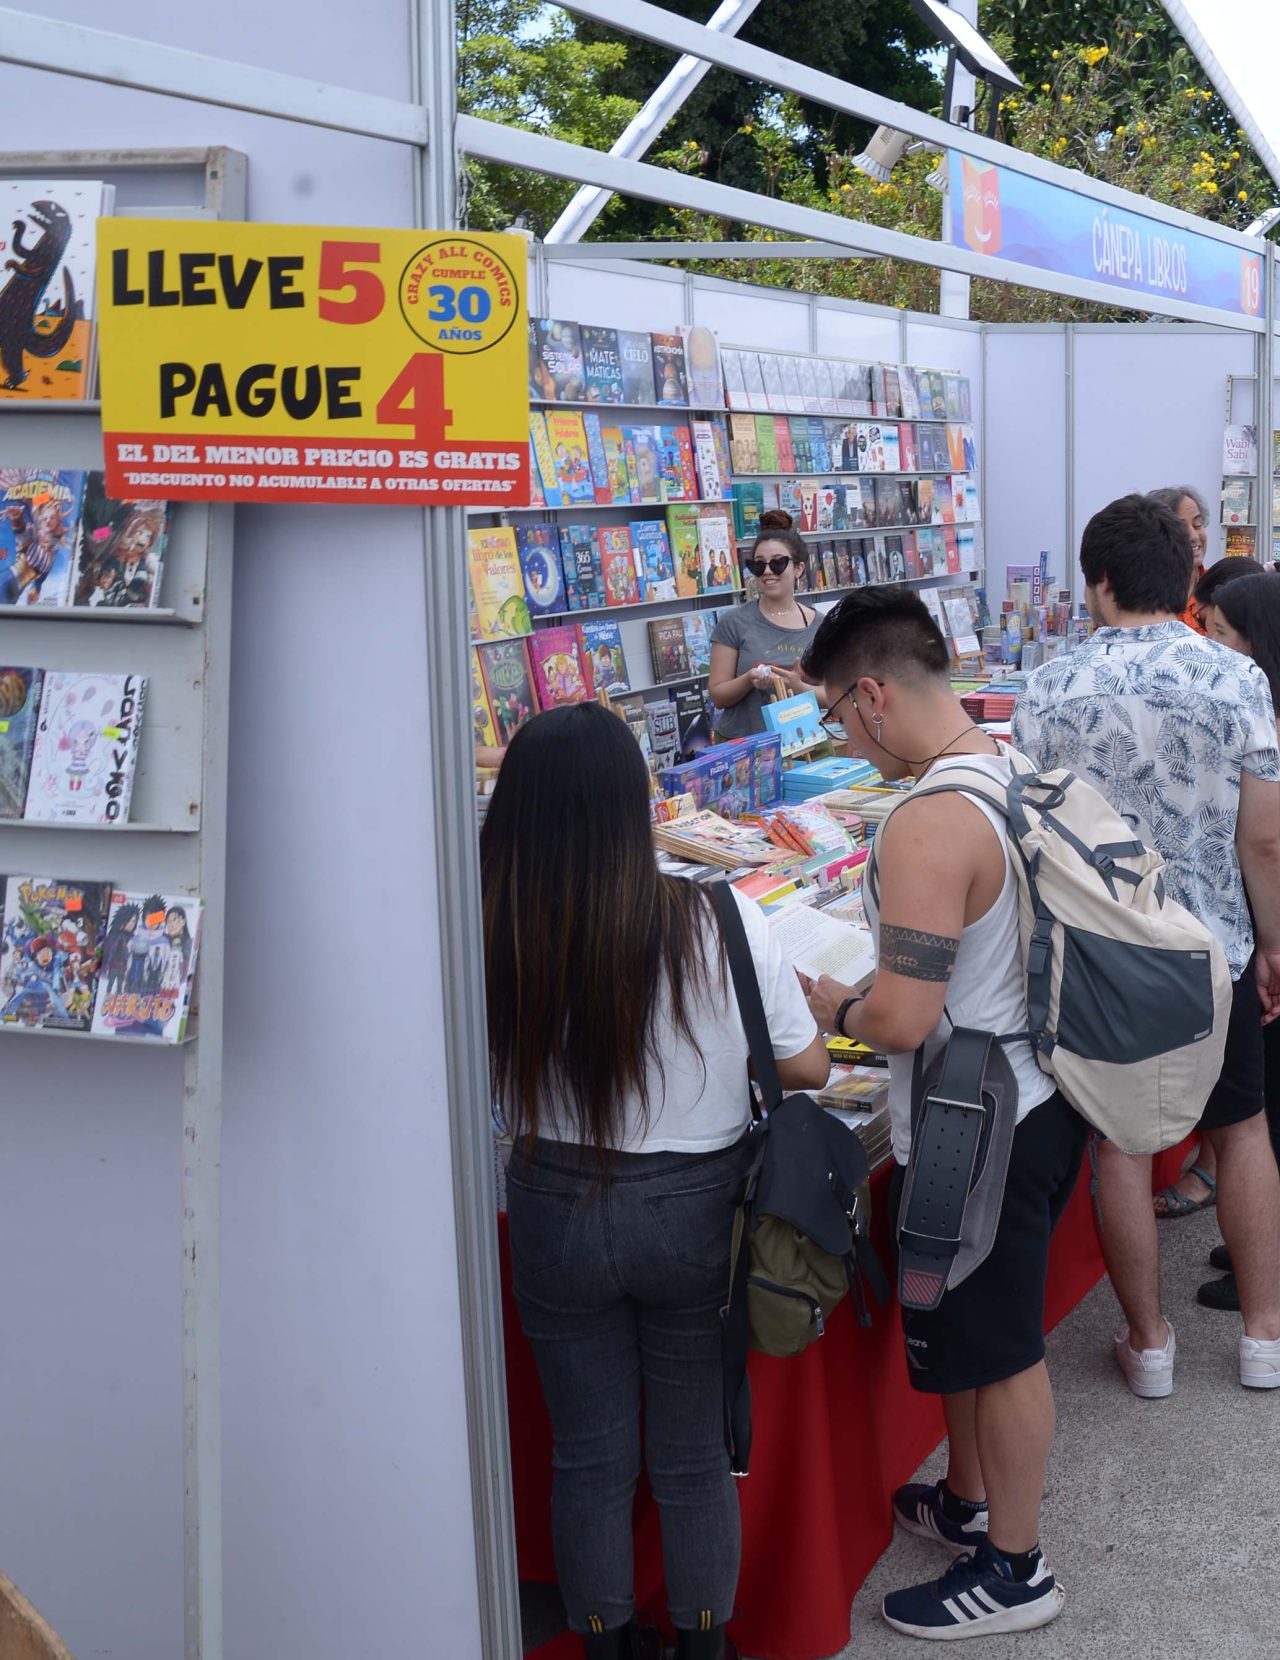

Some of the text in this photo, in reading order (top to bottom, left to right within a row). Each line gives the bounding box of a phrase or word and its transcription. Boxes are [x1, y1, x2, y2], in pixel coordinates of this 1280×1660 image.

[1092, 207, 1187, 294] CÁNEPA LIBROS
[112, 240, 386, 325] LLEVE 5
[407, 245, 511, 307] CRAZY ALL COMICS
[431, 268, 486, 280] CUMPLE
[1245, 266, 1260, 311] 19
[427, 284, 492, 324] 30
[438, 326, 483, 341] AÑOS
[159, 352, 454, 441] PAGUE 4
[117, 443, 521, 471] EL DEL MENOR PRECIO ES GRATIS
[1225, 437, 1250, 449] Wabi
[1227, 448, 1249, 460] Sabi
[229, 474, 254, 488] NO
[257, 475, 367, 490] ACUMULABLE
[370, 476, 383, 490] A
[385, 478, 440, 491] OTRAS
[654, 715, 677, 734] SUB
[101, 993, 175, 1023] NARUTO
